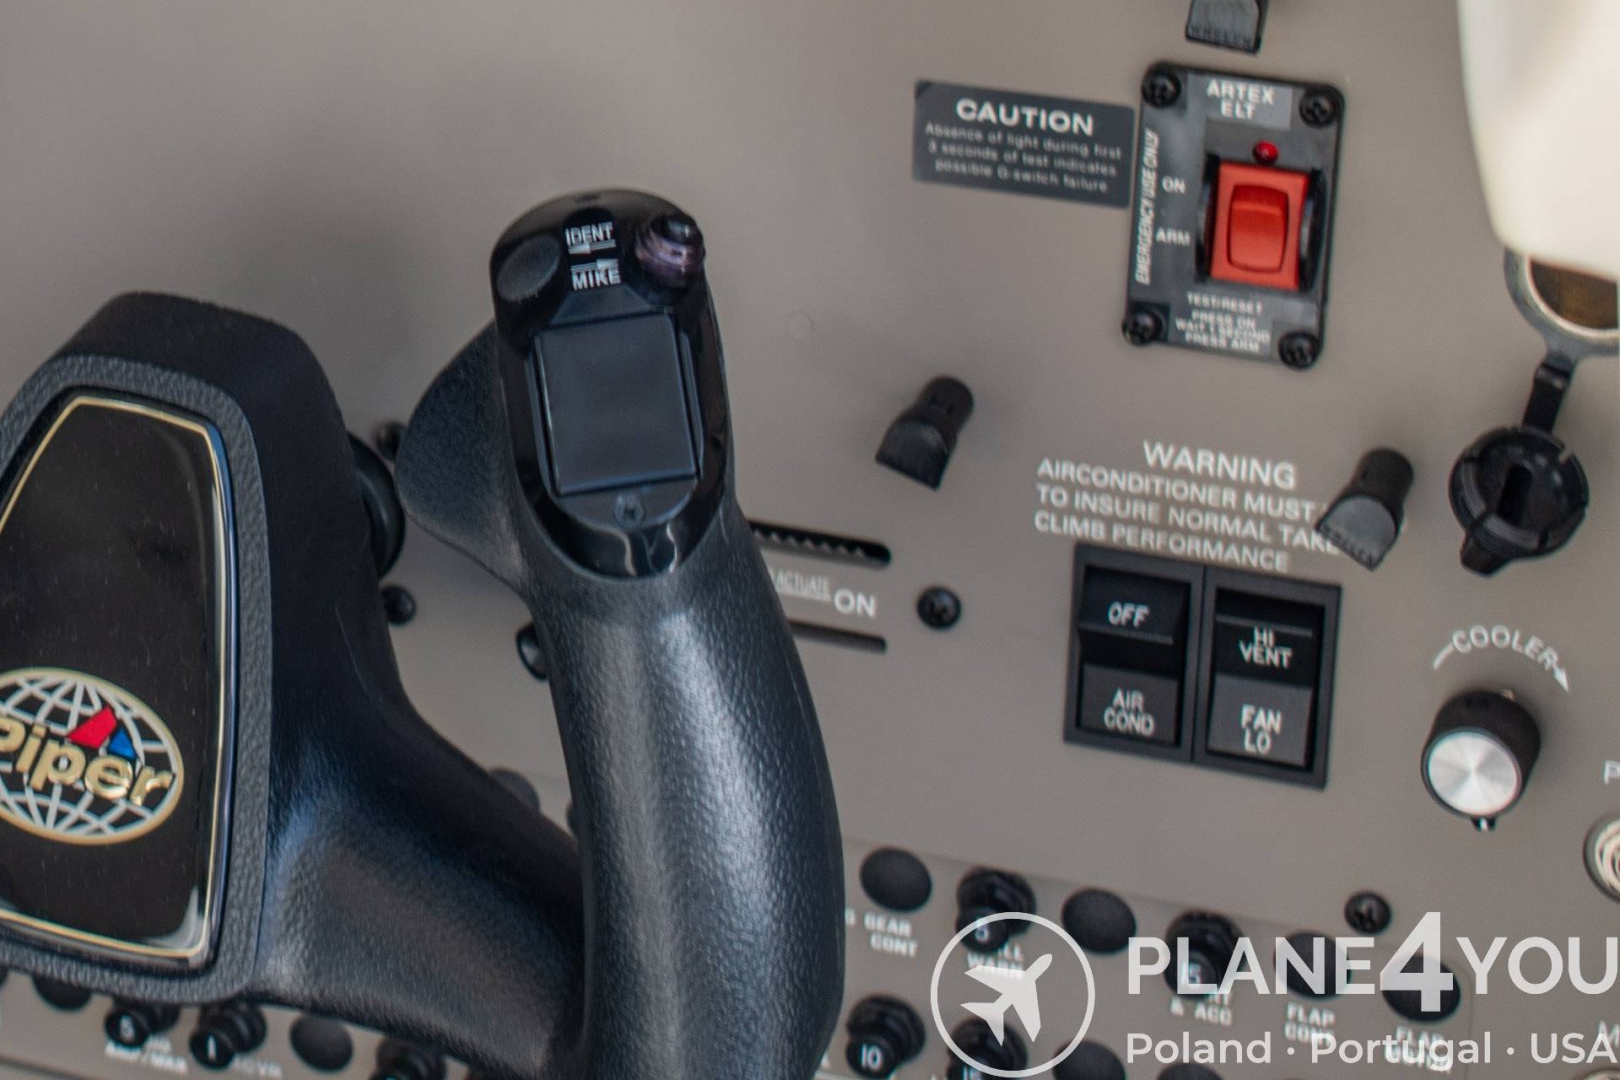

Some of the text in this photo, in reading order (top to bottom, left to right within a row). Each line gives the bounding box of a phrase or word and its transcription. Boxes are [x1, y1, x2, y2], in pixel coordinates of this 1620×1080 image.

[1206, 79, 1275, 105] ARTEX
[956, 98, 1093, 136] CAUTION
[1221, 99, 1255, 120] ELT
[926, 121, 1121, 160] Absence of light during first
[942, 142, 997, 162] seconds
[1004, 150, 1017, 164] of
[1022, 152, 1048, 167] test
[1054, 156, 1116, 176] indicates
[935, 160, 993, 178] possible
[1063, 175, 1107, 193] failure
[1163, 176, 1185, 194] ON
[565, 221, 614, 246] IDENT
[1156, 228, 1190, 246] ARM
[572, 268, 621, 291] MIKE
[1143, 440, 1296, 491] WARNING
[1037, 458, 1315, 522] AIRCONDITIONER MUST
[1036, 483, 1068, 508] TO
[1075, 492, 1161, 525] INSURE
[1168, 508, 1273, 544] NORMAL
[1034, 511, 1289, 573] CLIMB PERFORMANCE
[834, 588, 876, 617] ON
[1108, 601, 1149, 627] OFF
[1253, 627, 1275, 646] HI
[1452, 625, 1559, 670] COOLER
[1239, 641, 1292, 669] VENT
[1112, 687, 1144, 711] AIR
[1104, 706, 1155, 736] COND
[1241, 704, 1282, 734] FAN
[1244, 730, 1272, 755] LO
[865, 911, 912, 937] GEAR
[871, 933, 918, 958] CONT
[1287, 1001, 1335, 1026] FLAP
[861, 1043, 882, 1070] 10
